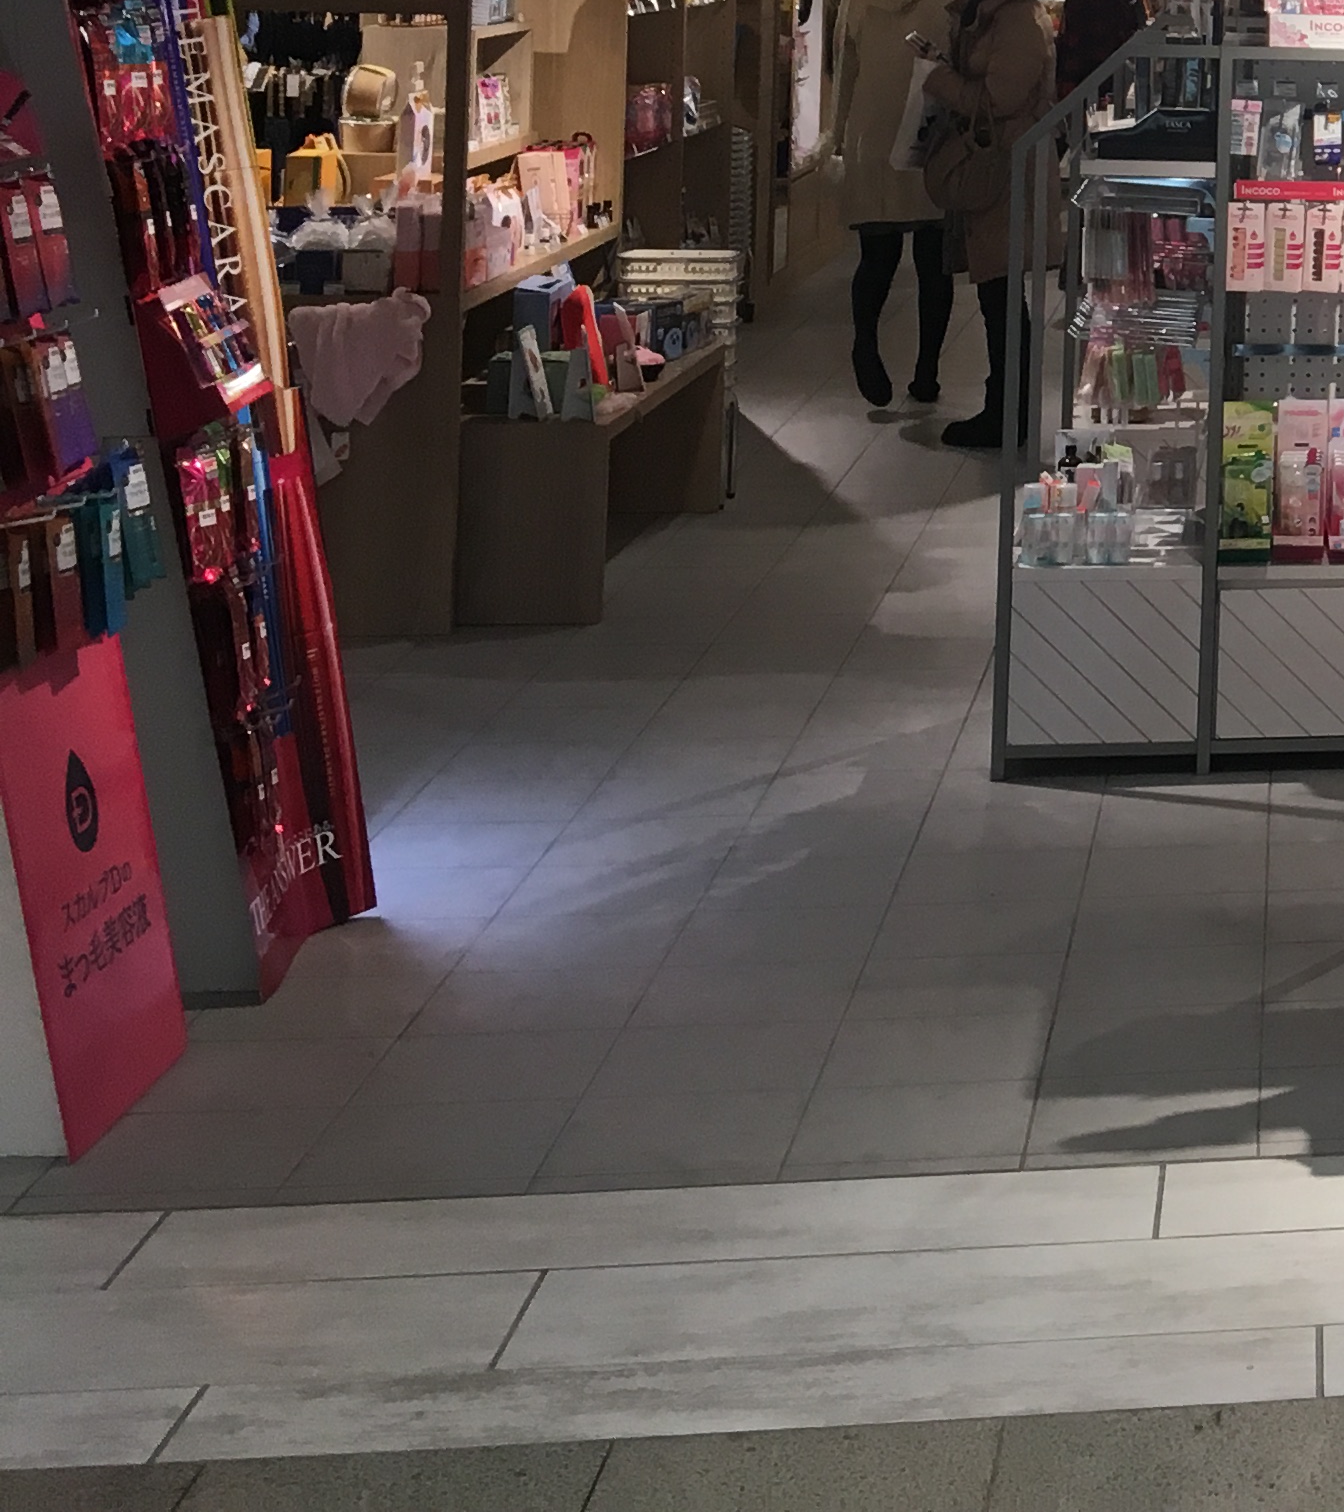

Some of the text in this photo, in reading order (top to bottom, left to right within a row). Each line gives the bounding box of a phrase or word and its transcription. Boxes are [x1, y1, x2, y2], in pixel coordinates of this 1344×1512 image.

[1241, 185, 1280, 196] INCOCO
[60, 861, 132, 934] スカルプDの
[57, 893, 151, 998] まつ毛美容液
